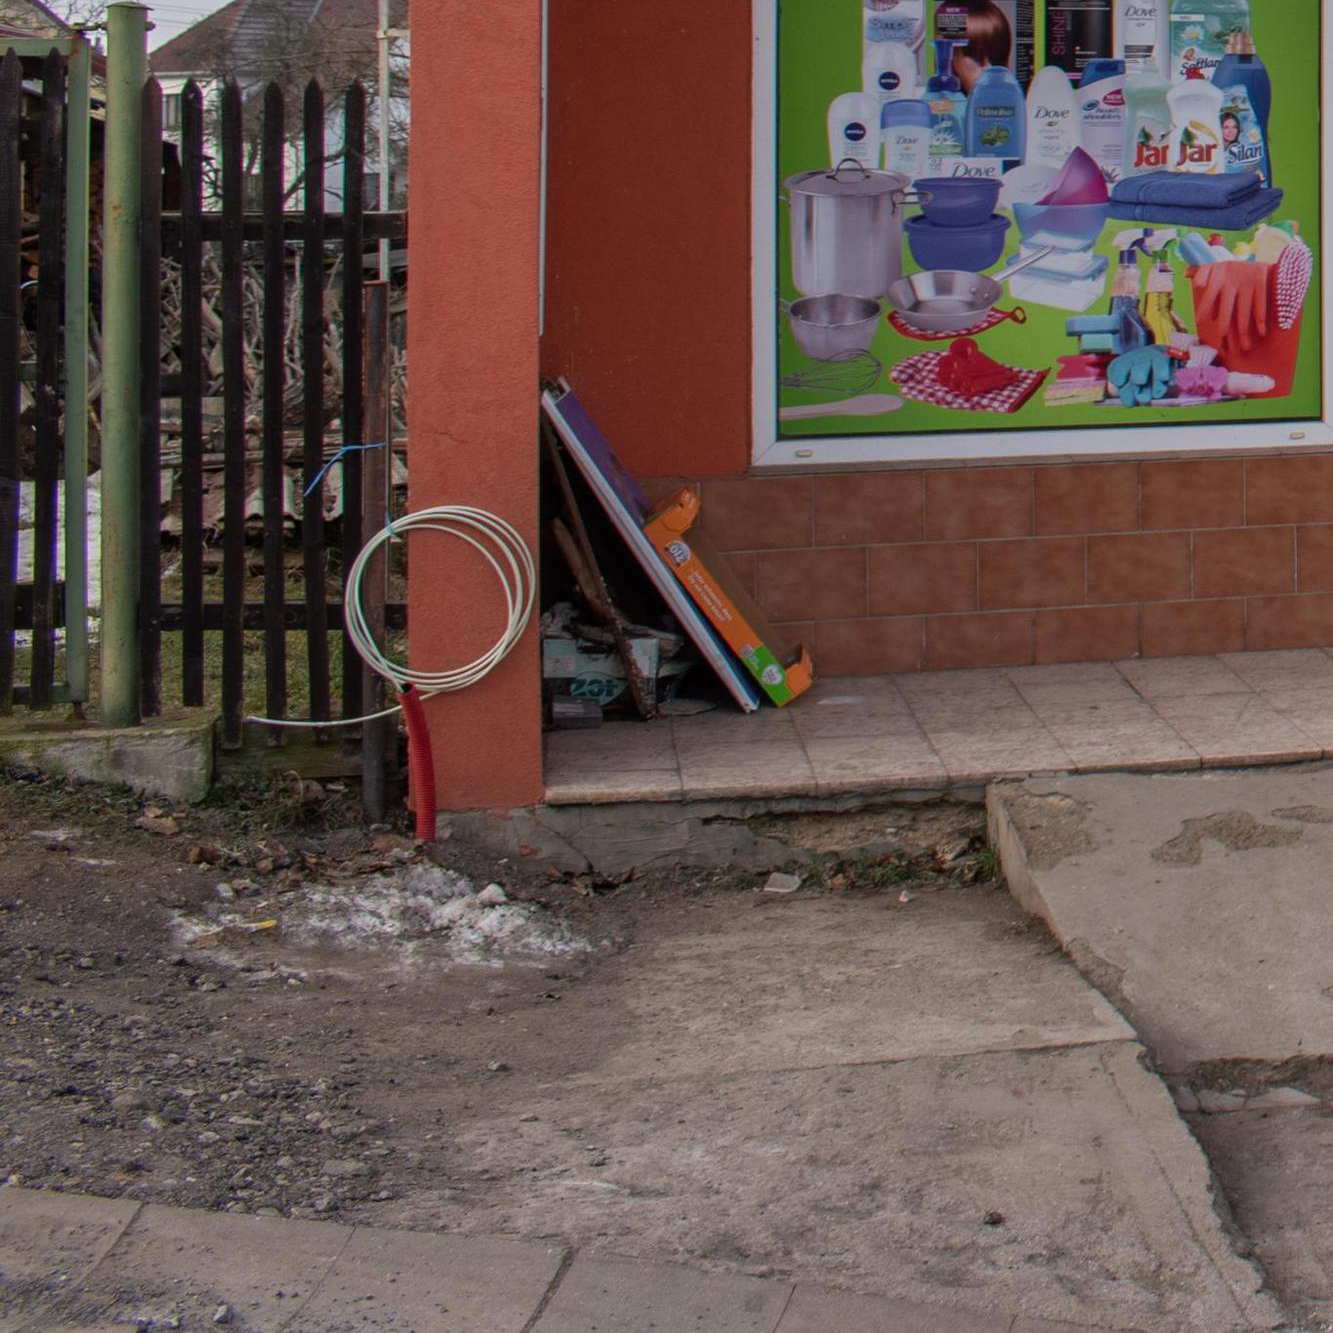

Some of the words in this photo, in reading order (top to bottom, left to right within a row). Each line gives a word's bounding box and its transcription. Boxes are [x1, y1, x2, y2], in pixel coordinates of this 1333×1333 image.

[1124, 5, 1158, 17] Dove
[1051, 10, 1067, 56] SHINE
[1034, 105, 1070, 119] Dove
[895, 135, 919, 145] Dove
[1134, 141, 1169, 168] Jar
[1176, 140, 1218, 166] Jar
[1227, 141, 1263, 164] Silan
[952, 161, 997, 178] Dove
